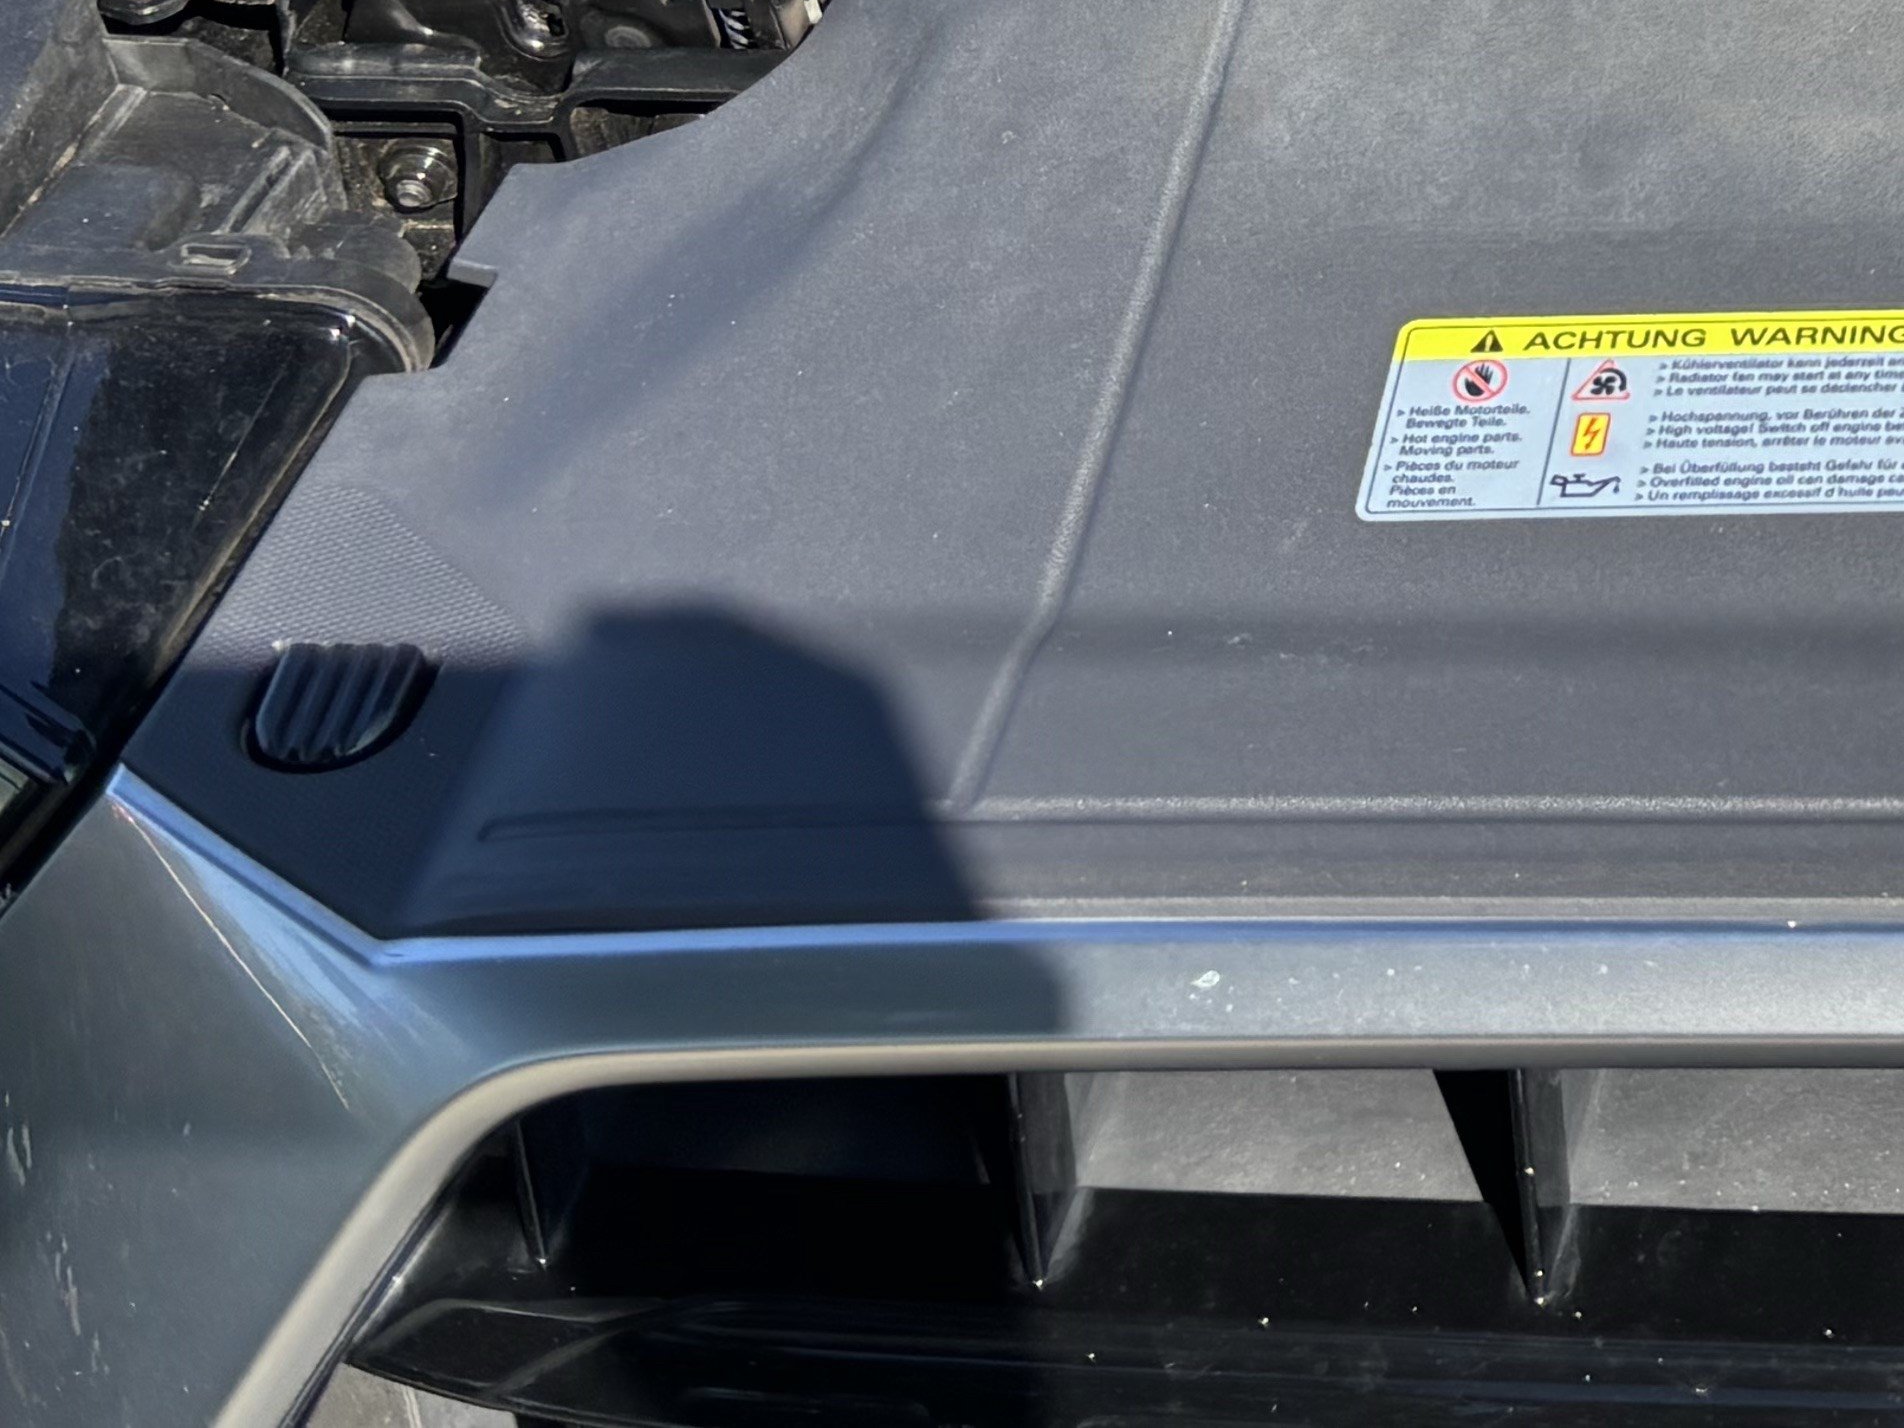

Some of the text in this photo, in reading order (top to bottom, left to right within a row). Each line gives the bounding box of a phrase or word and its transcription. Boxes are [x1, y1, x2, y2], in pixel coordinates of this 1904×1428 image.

[1524, 328, 1706, 351] ACHTUNG
[1669, 372, 1729, 383] Radiator
[1758, 373, 1789, 384] may
[1793, 370, 1824, 381] start
[1845, 372, 1870, 383] any
[1666, 385, 1684, 396] Le
[1688, 384, 1761, 396] ventilateur
[1765, 383, 1797, 396] peut
[1410, 405, 1531, 416] Heiße Motorteile.
[1872, 407, 1895, 419] der
[1406, 416, 1506, 429] Bewegte Teile.
[1658, 423, 1692, 437] High
[1758, 421, 1806, 434] Switch
[1810, 421, 1830, 432] off
[1833, 422, 1881, 434] engine
[1402, 432, 1522, 445] Hot engine parts.
[1656, 437, 1698, 449] Haute
[1762, 435, 1809, 447] arrêter
[1814, 435, 1826, 446] le
[1830, 434, 1881, 446] moteur
[1400, 445, 1494, 457] Moving parts.
[1396, 460, 1519, 471] Pièces du moteur
[1653, 462, 1676, 474] Bei
[1769, 460, 1821, 472] besteht
[1826, 459, 1873, 471] Gefahr
[1877, 458, 1898, 470] für
[1392, 473, 1455, 484] chaudes.
[1650, 476, 1720, 488] Overfilled
[1724, 476, 1772, 488] engine
[1776, 475, 1794, 485] oil
[1799, 475, 1823, 484] can
[1827, 474, 1884, 487] damage
[1389, 485, 1456, 495] Pièces en
[1648, 489, 1669, 501] Un
[1673, 488, 1759, 502] remplissage
[1763, 487, 1821, 499] excessif
[1387, 497, 1475, 508] mouvement.
